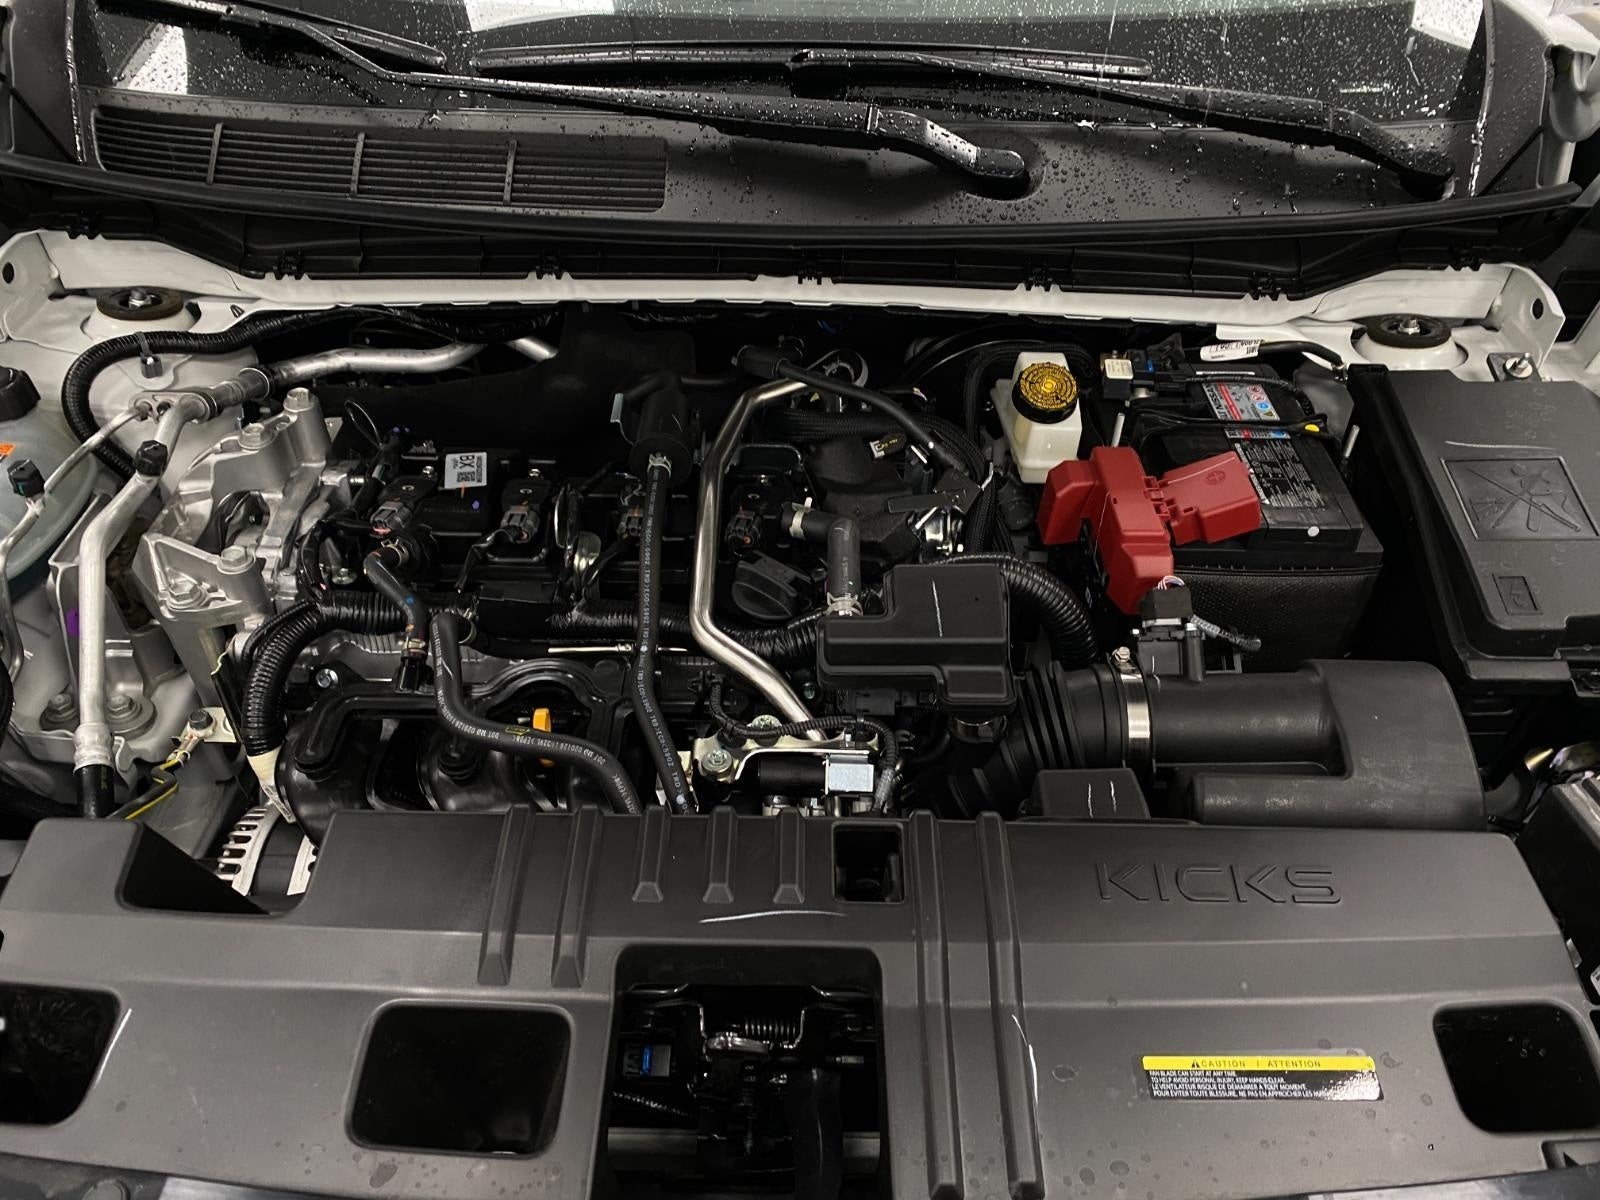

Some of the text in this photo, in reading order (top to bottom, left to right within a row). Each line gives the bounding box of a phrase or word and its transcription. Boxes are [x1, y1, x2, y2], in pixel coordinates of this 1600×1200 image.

[459, 455, 475, 469] BX
[1095, 863, 1342, 904] KICKS
[1201, 1060, 1321, 1068] CAUTION ATTENTION
